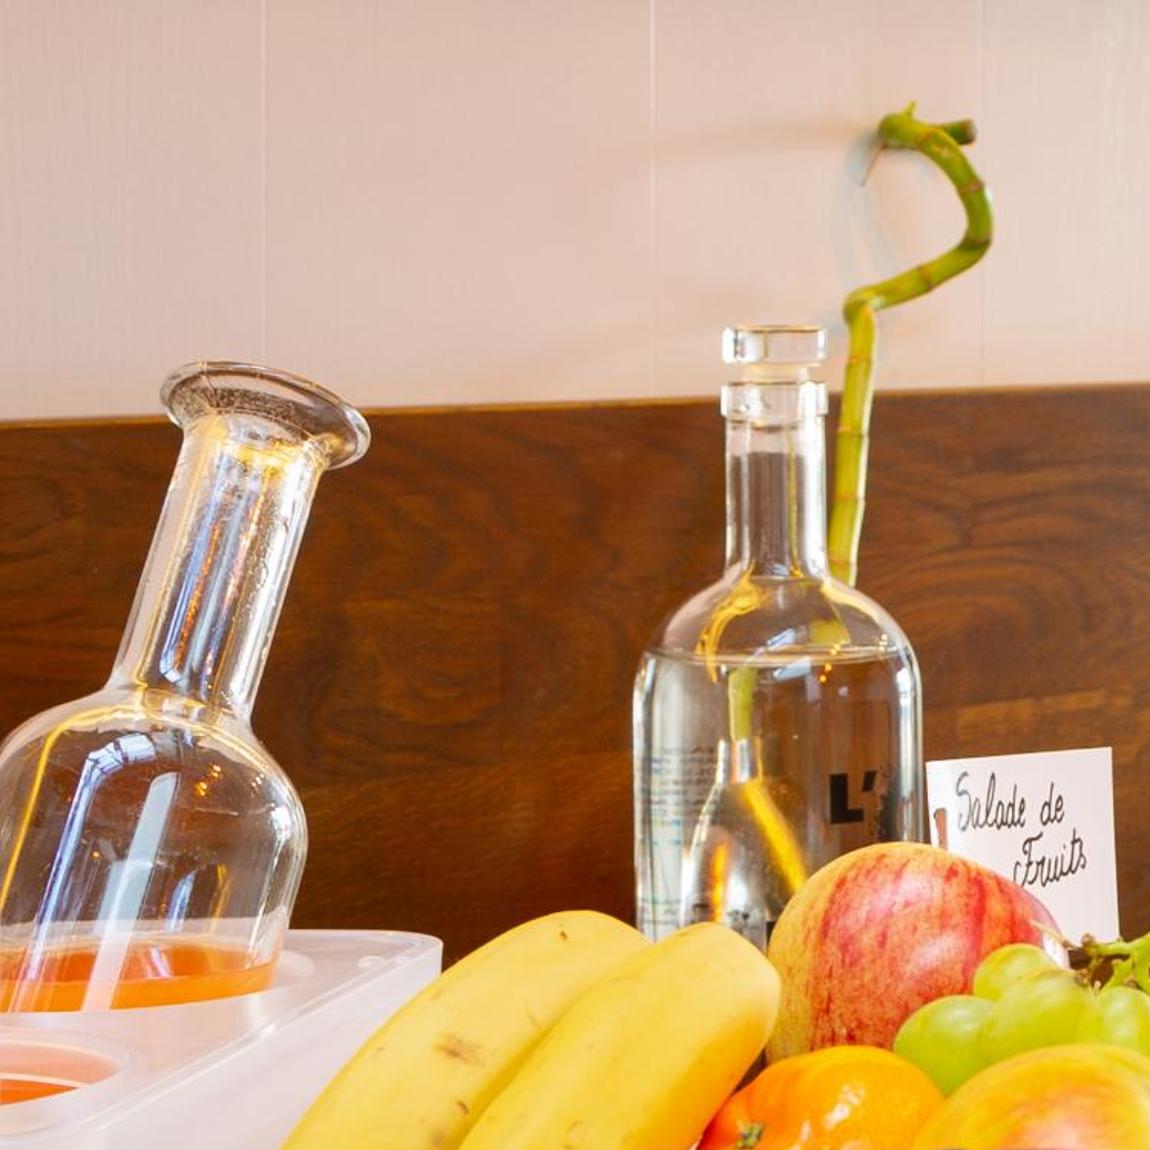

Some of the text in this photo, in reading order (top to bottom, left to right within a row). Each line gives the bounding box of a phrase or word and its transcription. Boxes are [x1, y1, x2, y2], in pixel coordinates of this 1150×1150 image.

[955, 771, 1065, 832] Salade de
[1013, 827, 1087, 888] Fruits
